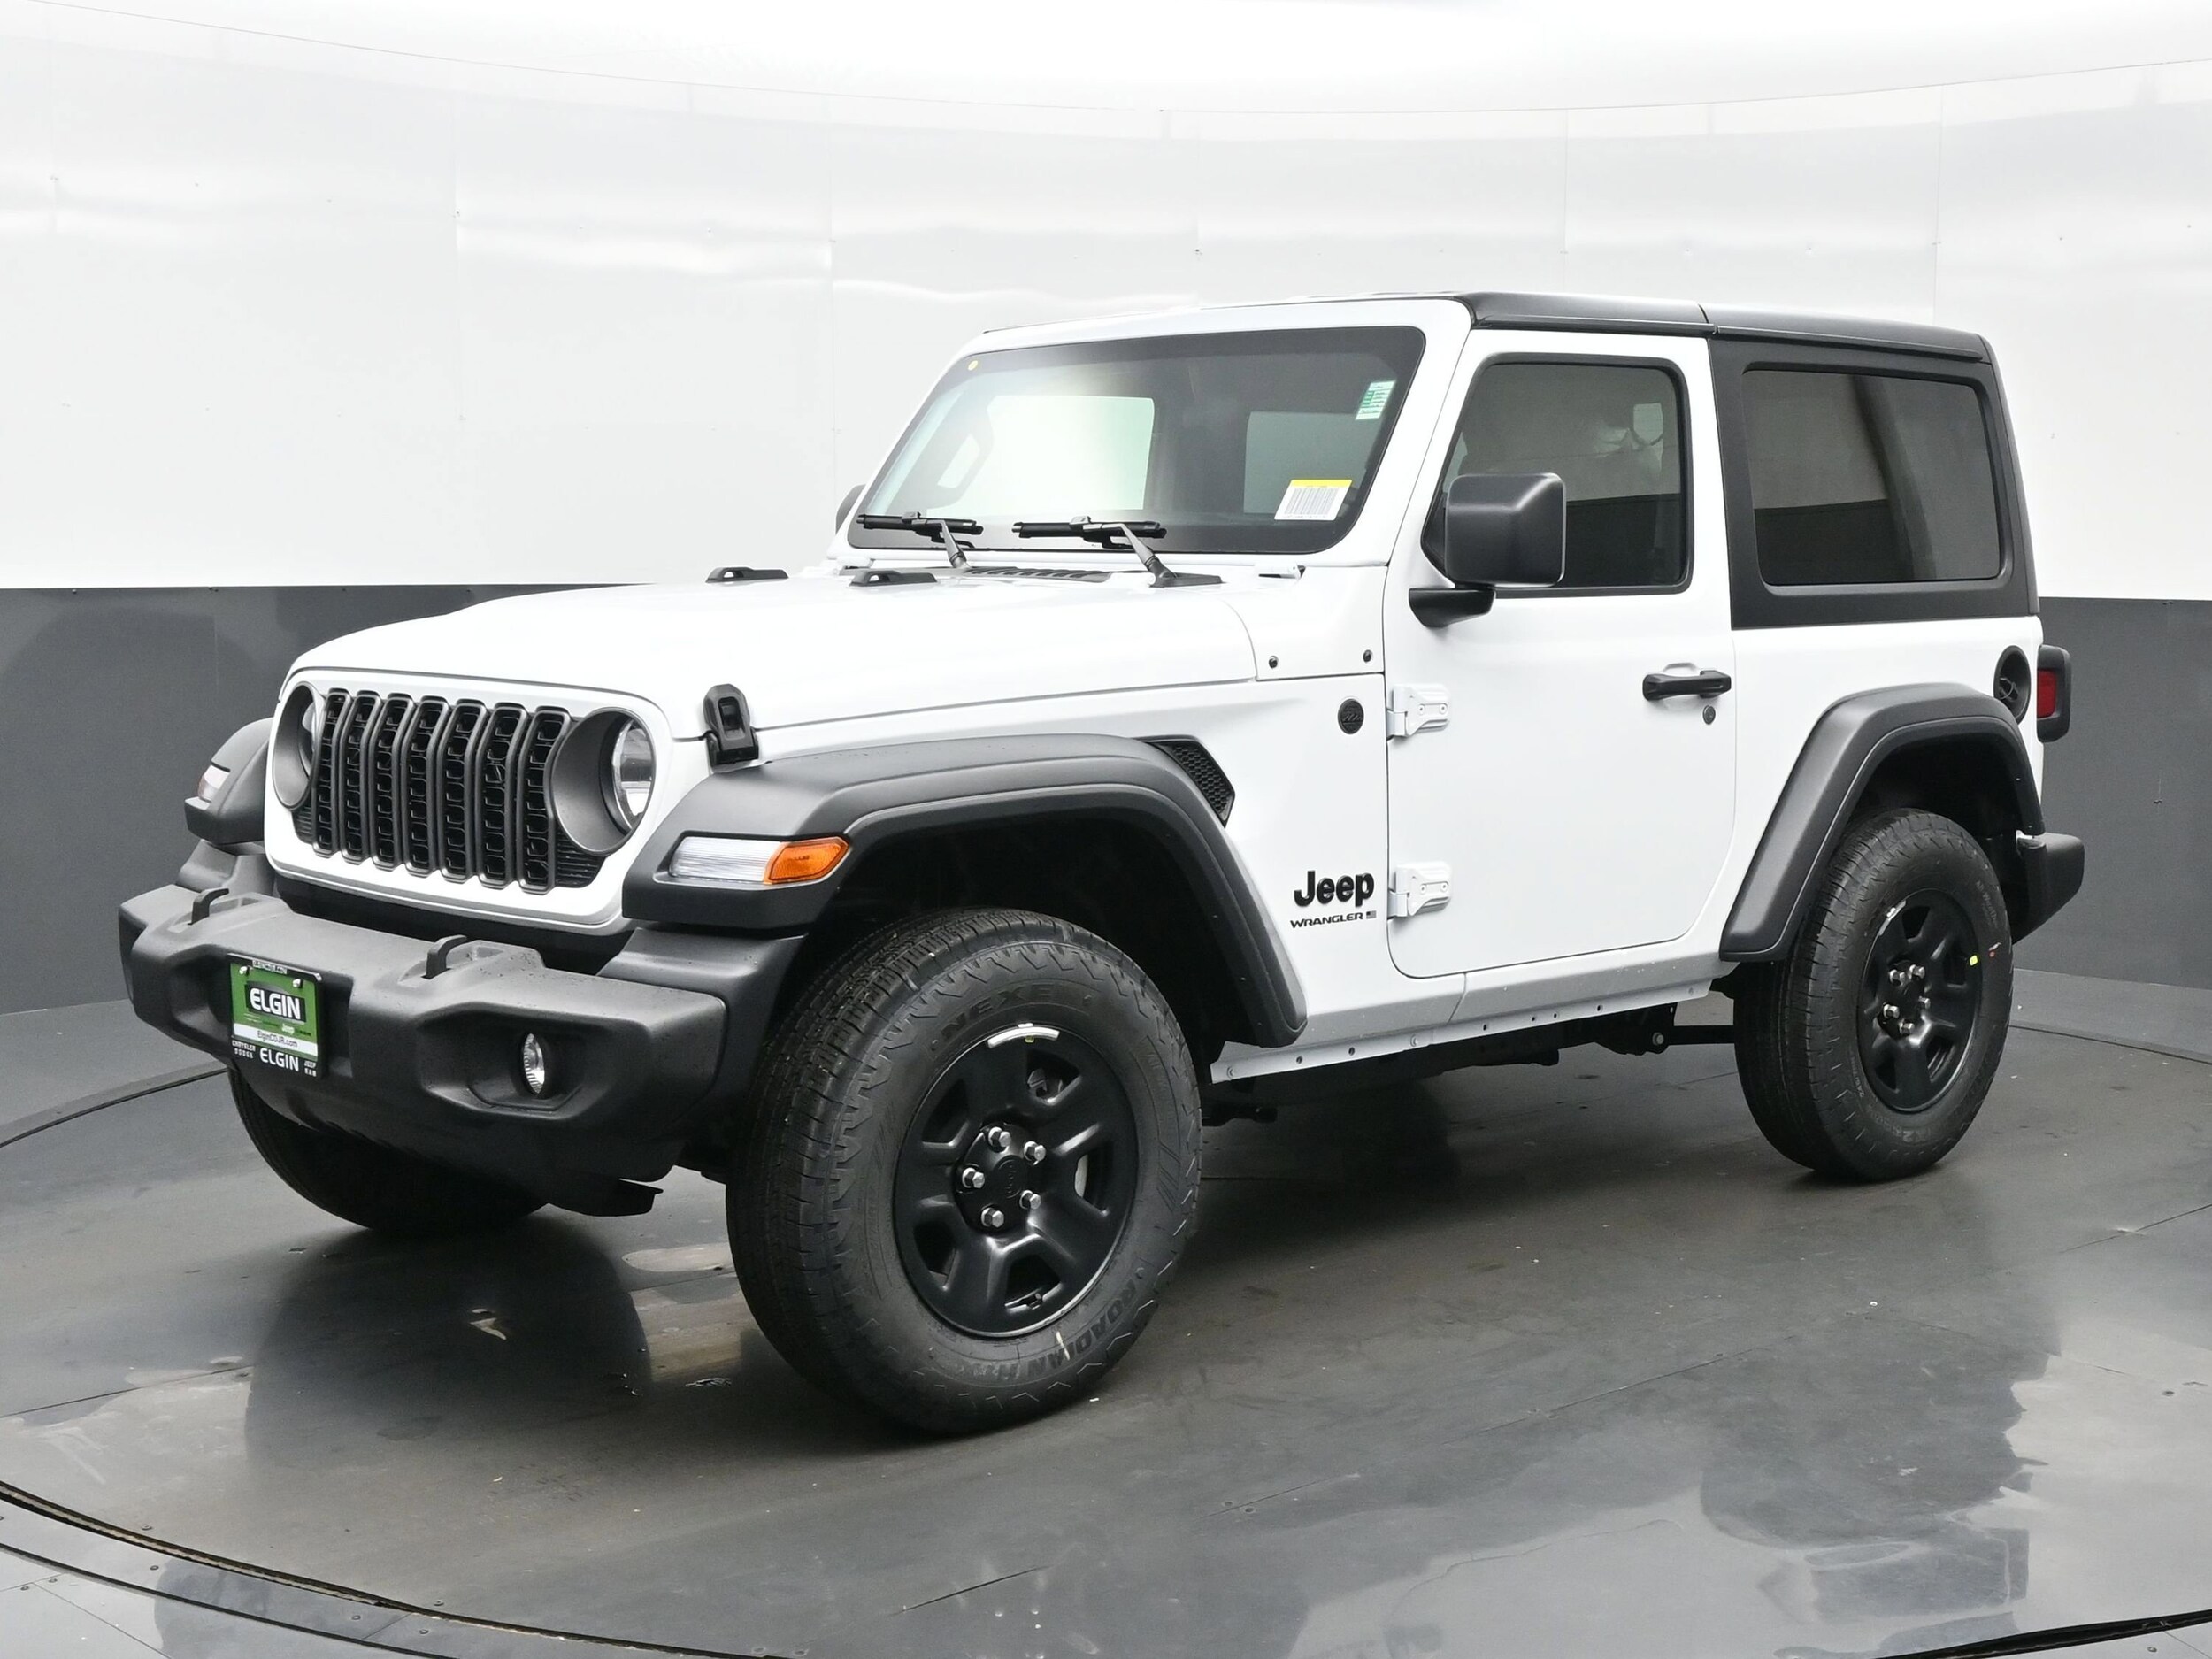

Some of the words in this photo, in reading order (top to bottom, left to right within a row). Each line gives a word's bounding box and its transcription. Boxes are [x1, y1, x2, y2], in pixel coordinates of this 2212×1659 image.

[1294, 870, 1374, 908] Jeep
[1290, 912, 1363, 929] WRANGLER
[250, 987, 301, 1020] ELGIN
[941, 981, 1079, 1042] NEXE
[232, 1040, 257, 1052] CHRYSLER
[234, 1048, 254, 1059] DODGE
[259, 1047, 299, 1072] ELGIN
